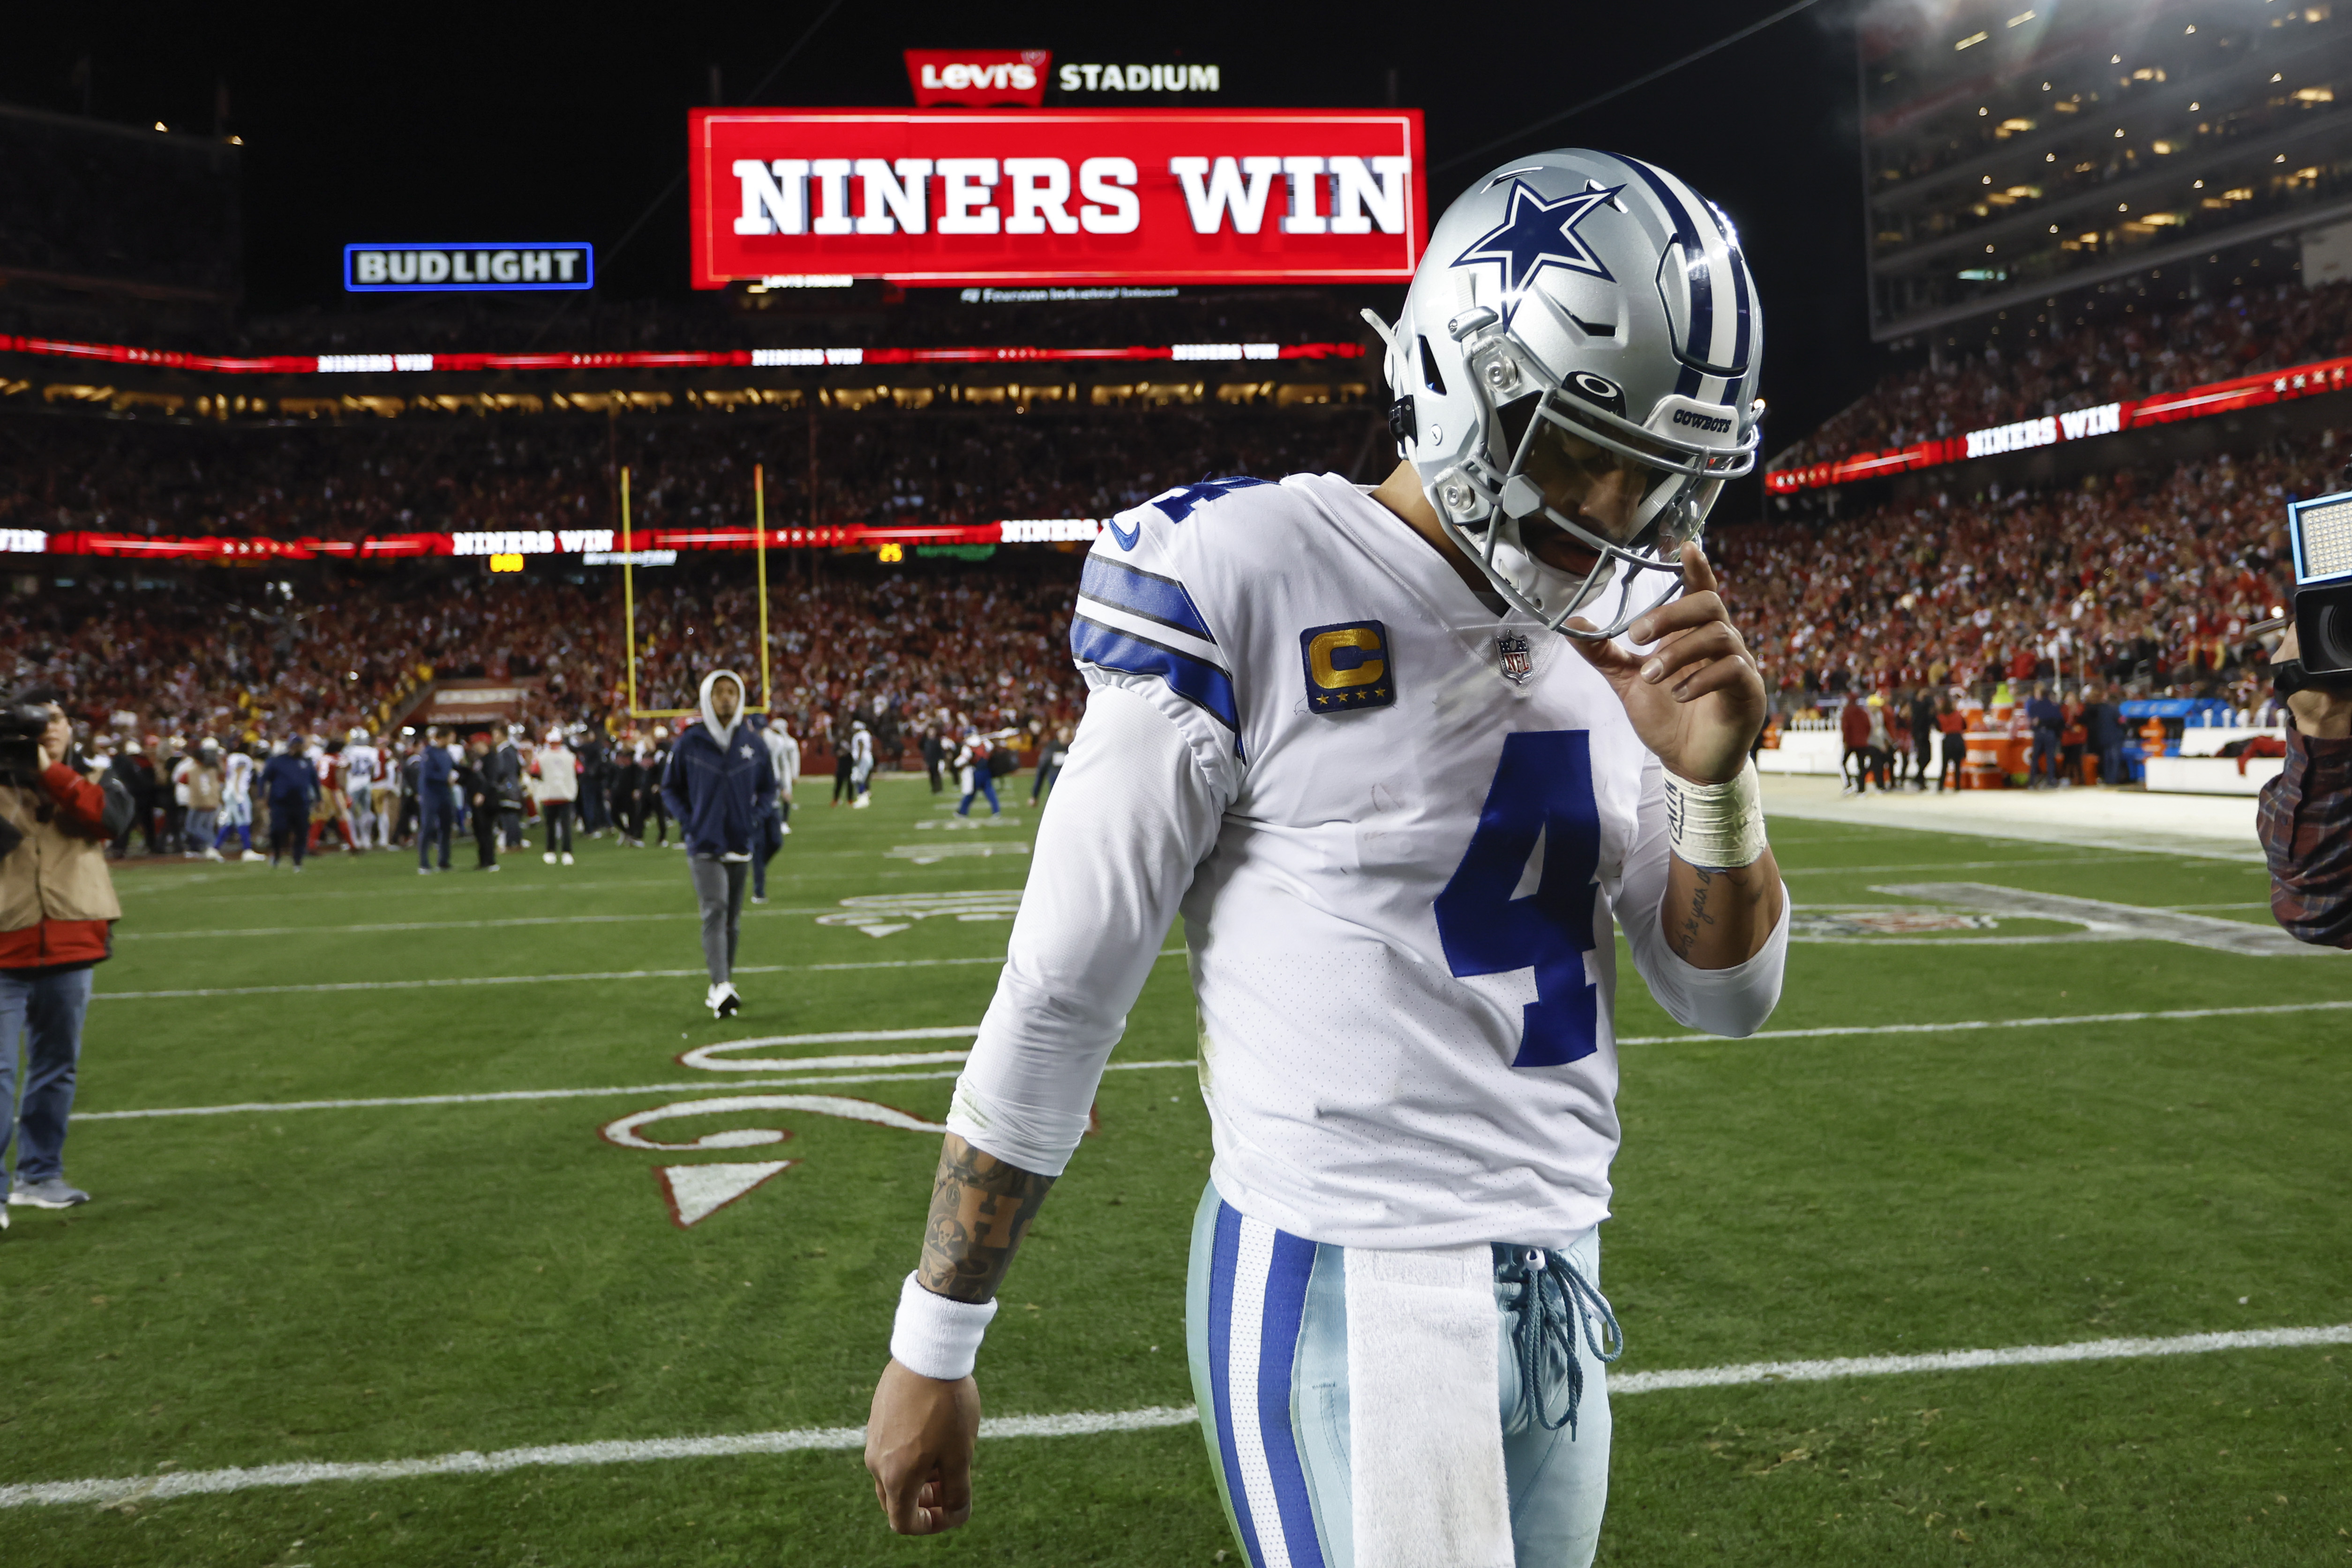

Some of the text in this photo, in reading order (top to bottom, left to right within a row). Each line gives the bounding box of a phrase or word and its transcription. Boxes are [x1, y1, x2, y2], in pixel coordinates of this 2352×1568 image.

[1060, 64, 1219, 91] STADIUM
[732, 155, 1412, 235] NINERS WIN
[317, 353, 434, 373] NINERS WIN
[751, 348, 864, 366] NINERS WIN
[1171, 343, 1280, 361] NINERS WIN
[1673, 409, 1732, 434] COWBOYS
[1966, 402, 2120, 458] NINERS WIN
[452, 529, 614, 555] NINERS WIN
[1000, 518, 1099, 543] NINERS
[1309, 628, 1383, 689] C
[1504, 652, 1531, 674] NFL
[1434, 729, 1600, 1067] 4
